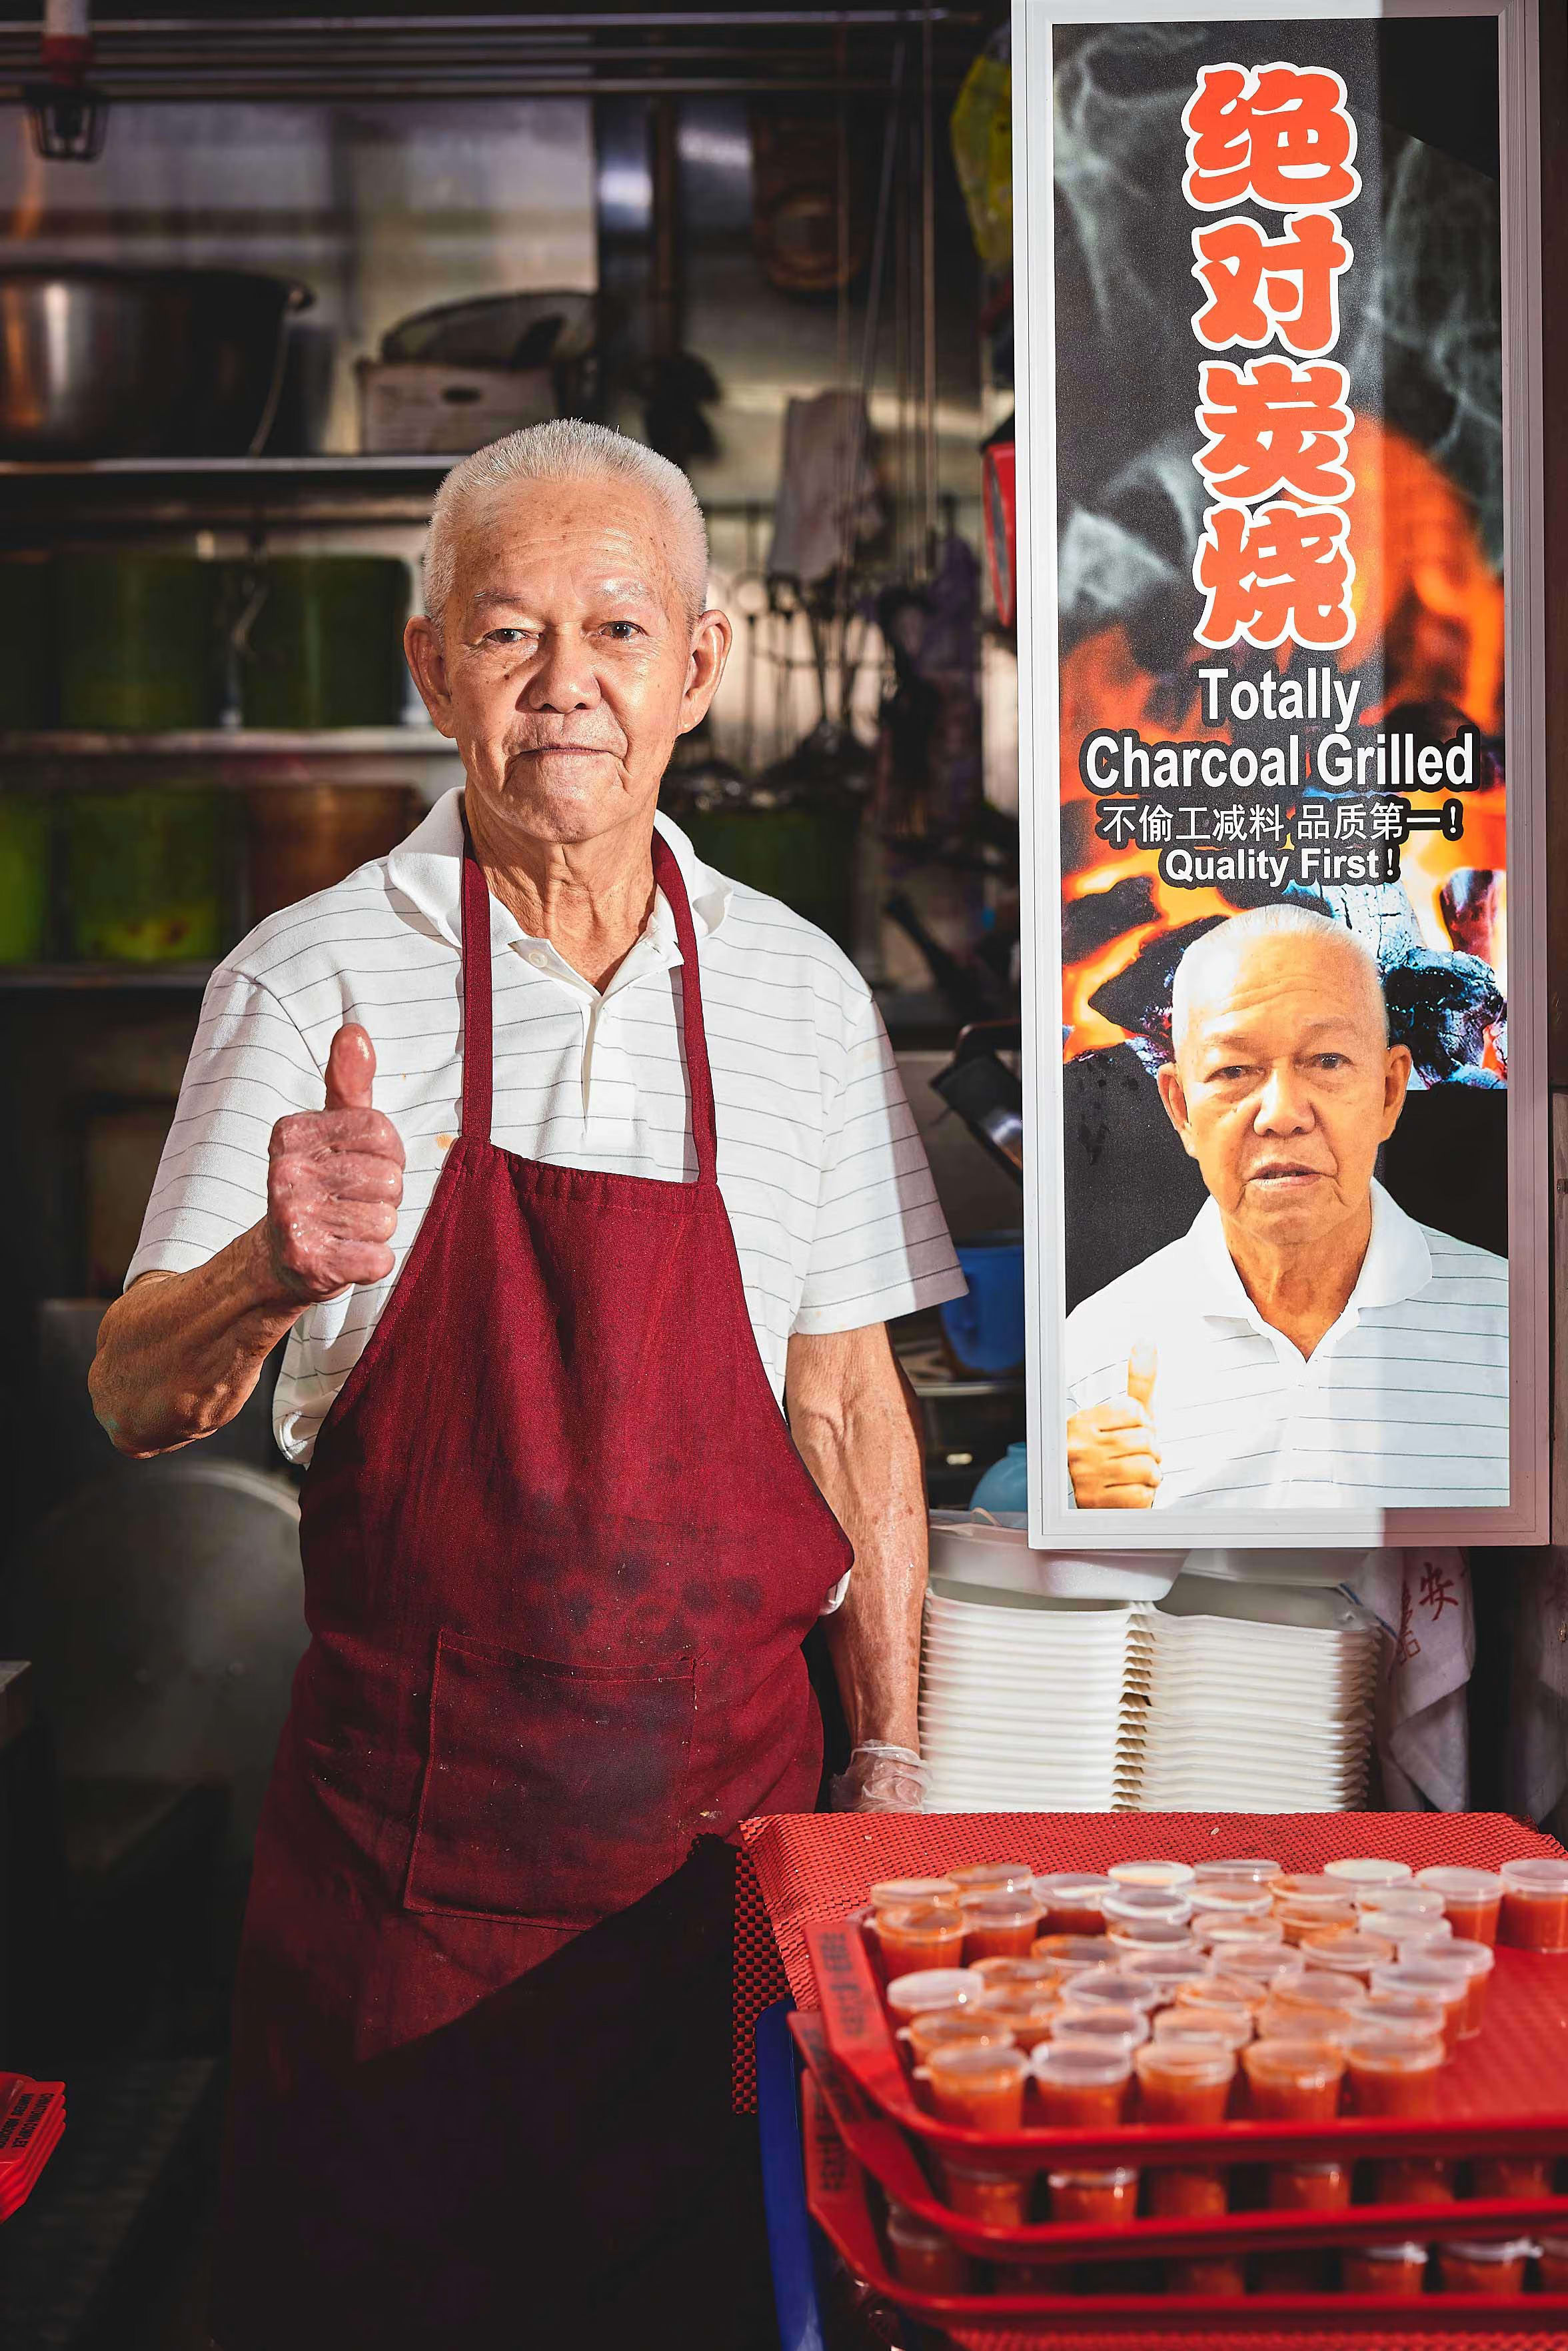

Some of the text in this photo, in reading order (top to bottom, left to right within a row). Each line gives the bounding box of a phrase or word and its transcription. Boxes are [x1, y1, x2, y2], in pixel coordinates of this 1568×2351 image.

[1183, 63, 1361, 650] 绝对炭烧
[1198, 667, 1361, 732] Totally
[1086, 732, 1474, 789] Charcoal Grilled
[1102, 803, 1285, 843] 不偷工减料
[1165, 848, 1289, 887] Quality
